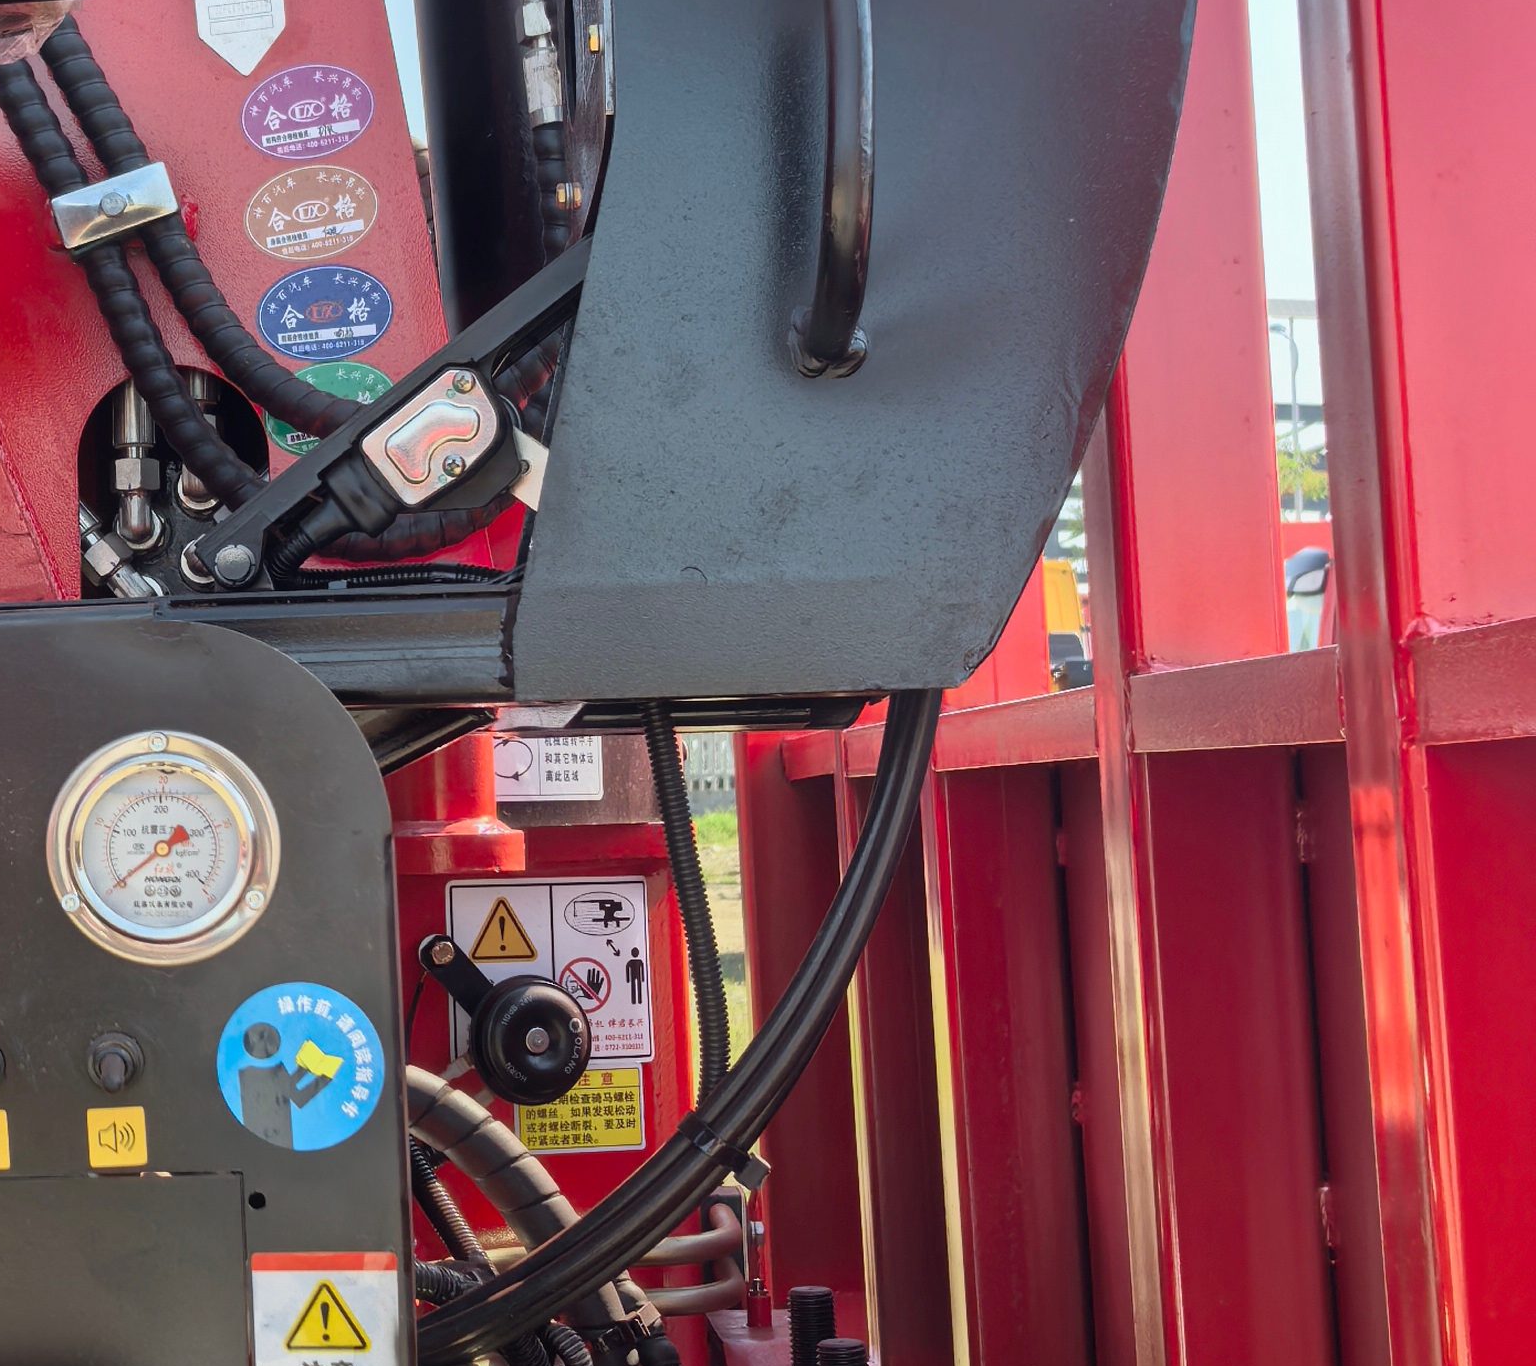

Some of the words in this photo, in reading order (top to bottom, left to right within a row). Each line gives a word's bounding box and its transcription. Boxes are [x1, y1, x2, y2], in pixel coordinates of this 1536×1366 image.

[313, 70, 362, 100] 长兴吊机
[264, 105, 287, 131] 合
[329, 93, 353, 120] 格
[316, 171, 366, 200] 长兴吊机
[268, 207, 291, 232] 合
[333, 194, 356, 220] 格
[333, 273, 381, 304] 长兴吊机
[281, 304, 304, 329] 合
[347, 297, 370, 323] 格
[545, 770, 579, 782] 离此区域
[123, 829, 136, 837] 100
[505, 1062, 527, 1082] HORN
[526, 1119, 636, 1133] 或者螺栓断裂，要及时
[526, 1133, 599, 1146] 拧紧或者更换。
